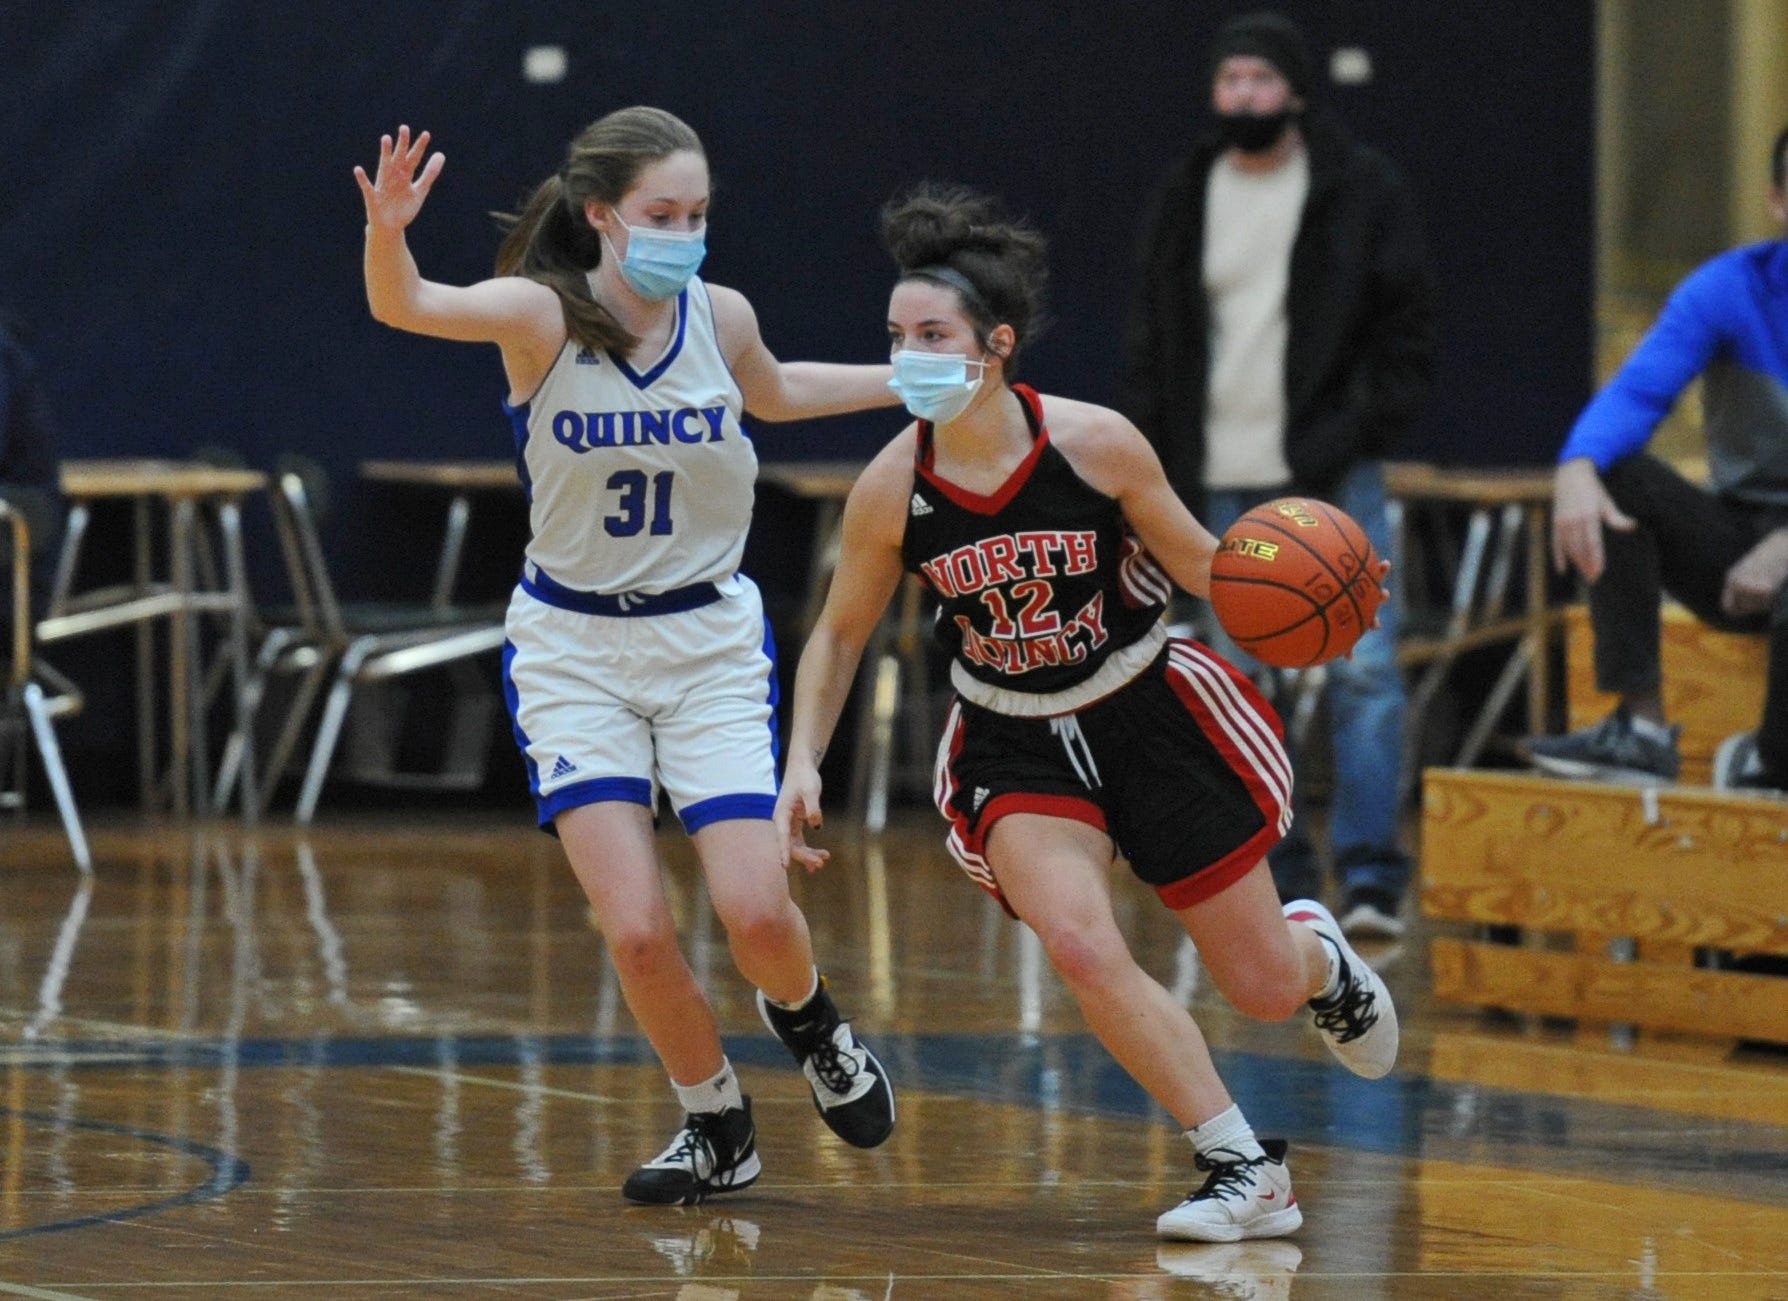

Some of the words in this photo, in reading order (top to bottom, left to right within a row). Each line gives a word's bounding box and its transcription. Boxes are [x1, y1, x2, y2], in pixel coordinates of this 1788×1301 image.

[552, 405, 726, 454] QUINCY
[603, 469, 675, 538] 31
[1217, 537, 1279, 562] LITE
[953, 589, 1109, 675] INCY
[980, 578, 1061, 640] 12
